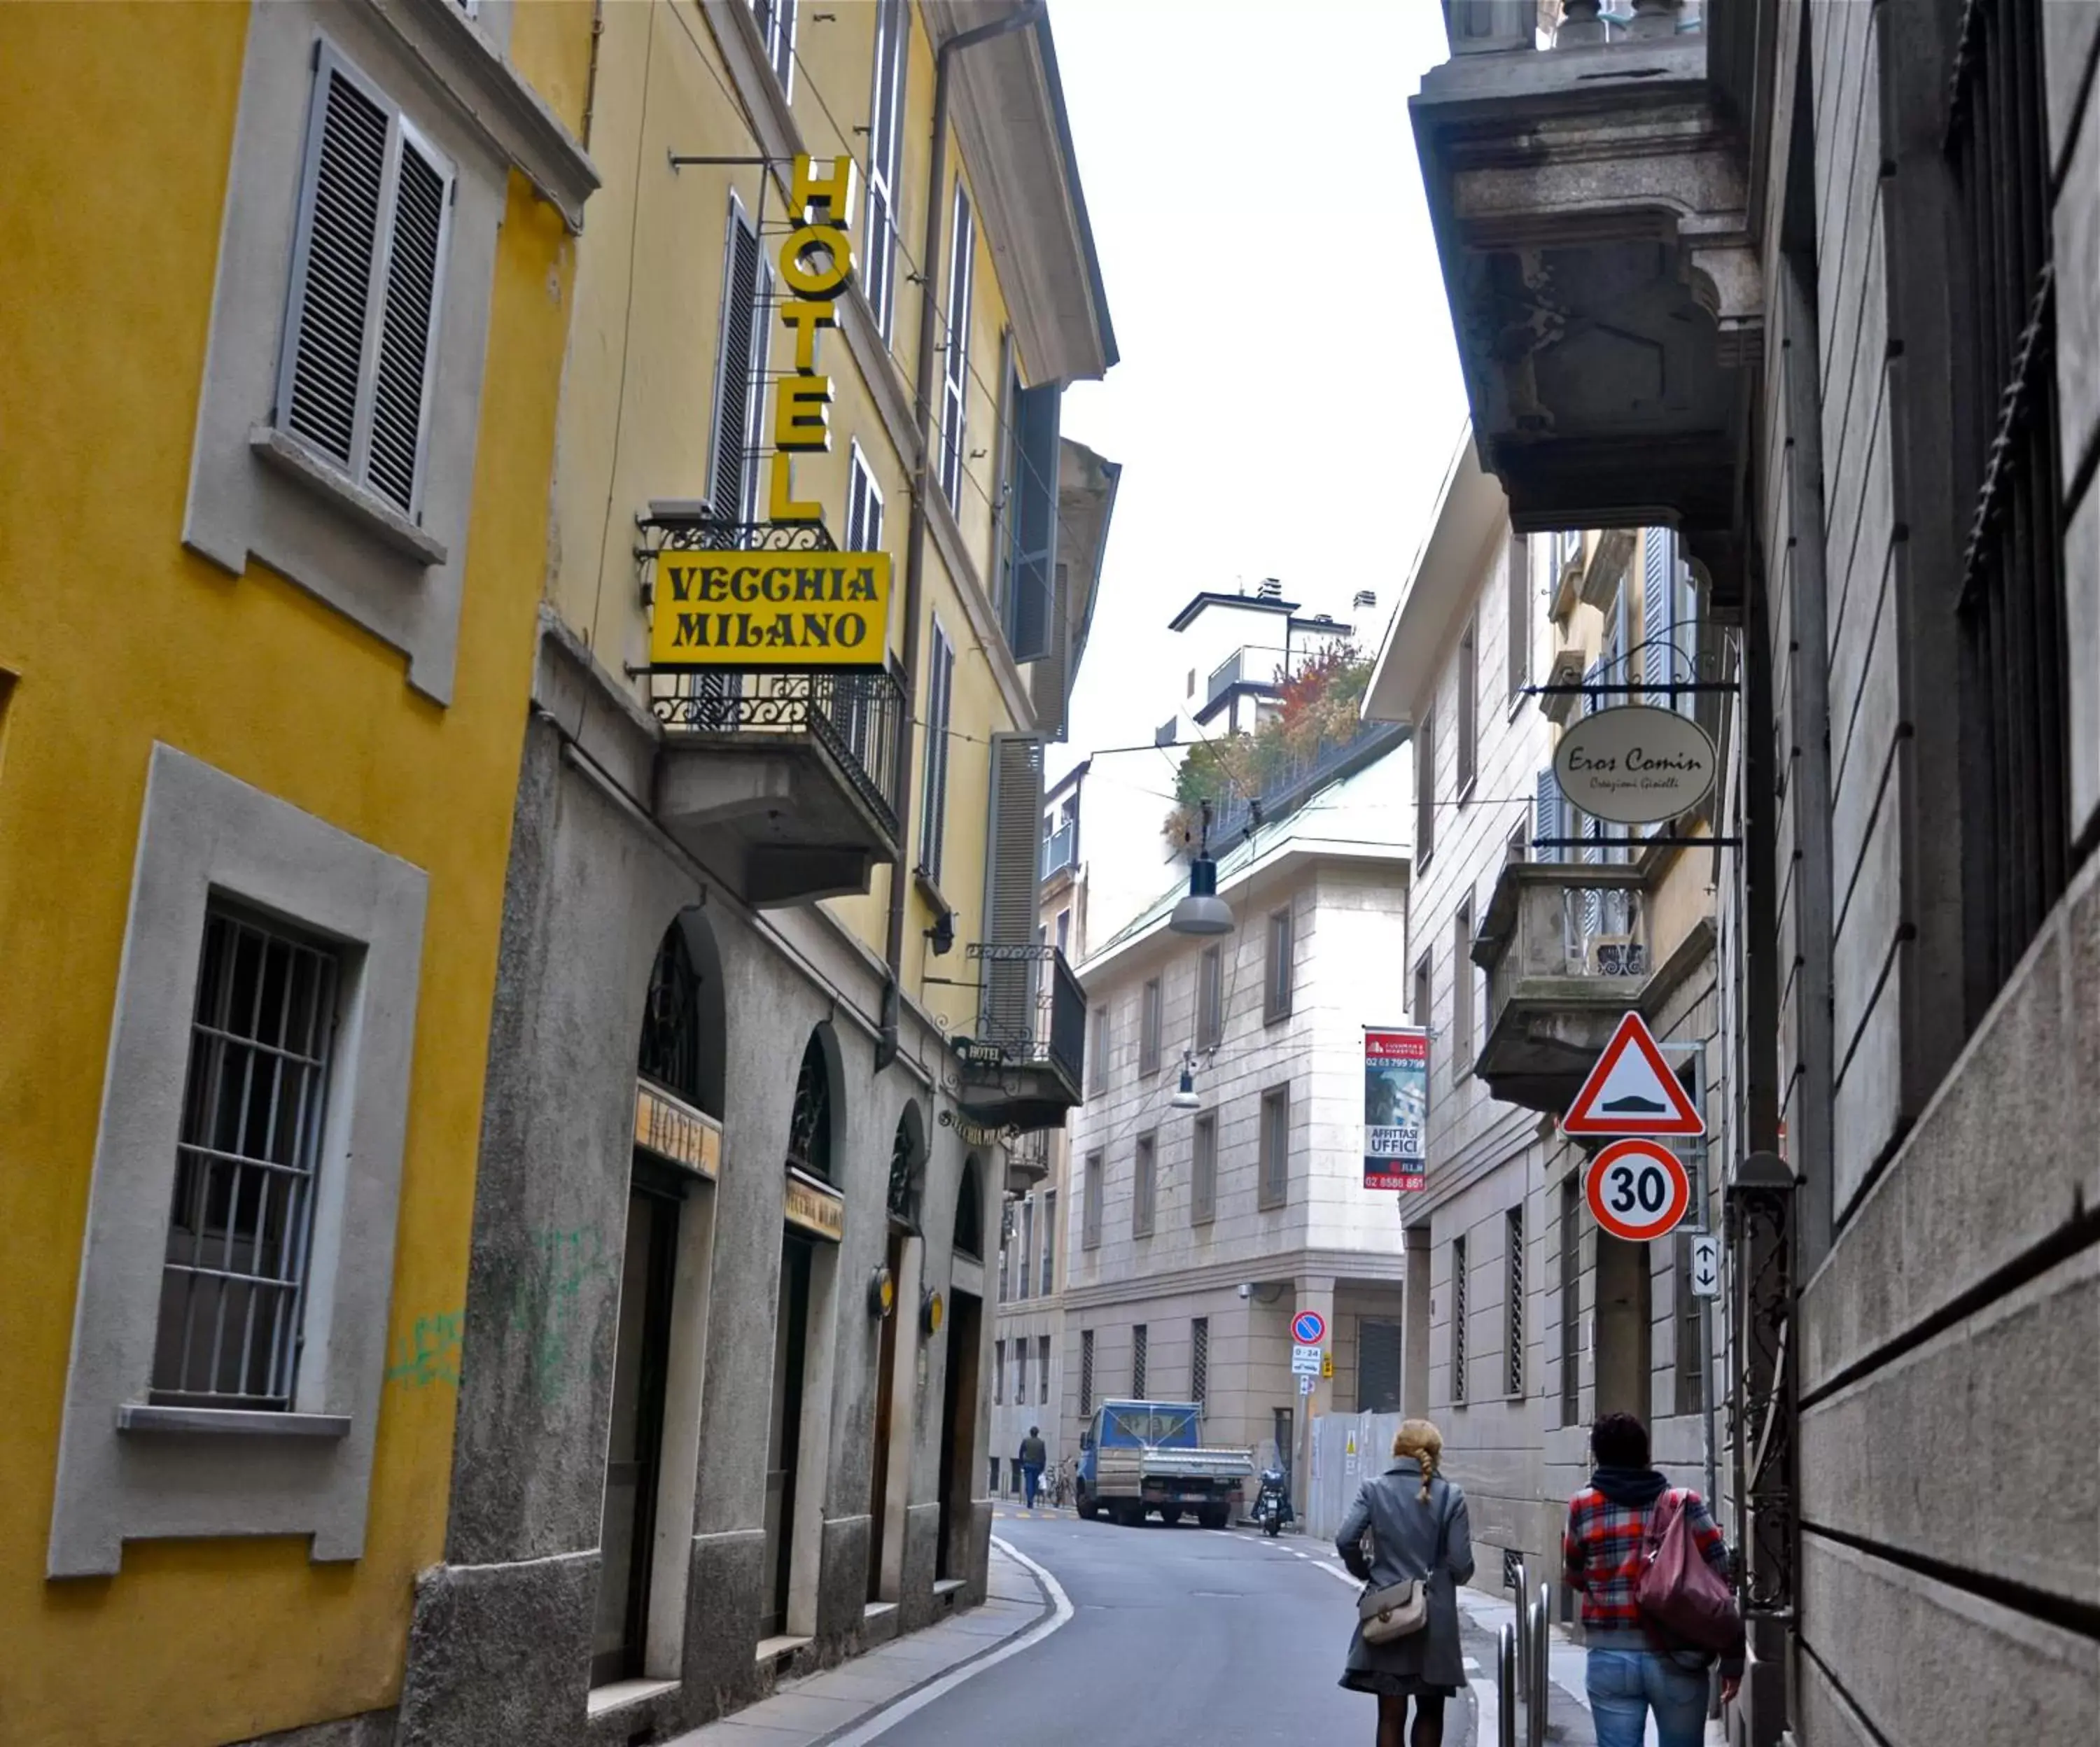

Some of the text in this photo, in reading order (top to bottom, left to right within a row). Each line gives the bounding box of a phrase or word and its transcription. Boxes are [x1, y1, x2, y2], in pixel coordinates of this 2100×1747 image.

[769, 153, 855, 524] HOTEL
[667, 566, 880, 603] VECCHIA
[671, 612, 868, 648] MILANO
[1569, 745, 1702, 771] Eros Comin
[969, 1045, 1000, 1062] HOTEL
[1366, 1058, 1377, 1066] 02
[1391, 1058, 1408, 1067] 799
[648, 1097, 707, 1172] HOTEL
[1371, 1128, 1418, 1139] AFFITTASI
[1371, 1139, 1418, 1153] UFFICI
[1366, 1176, 1378, 1187] 02
[1610, 1165, 1666, 1213] 30
